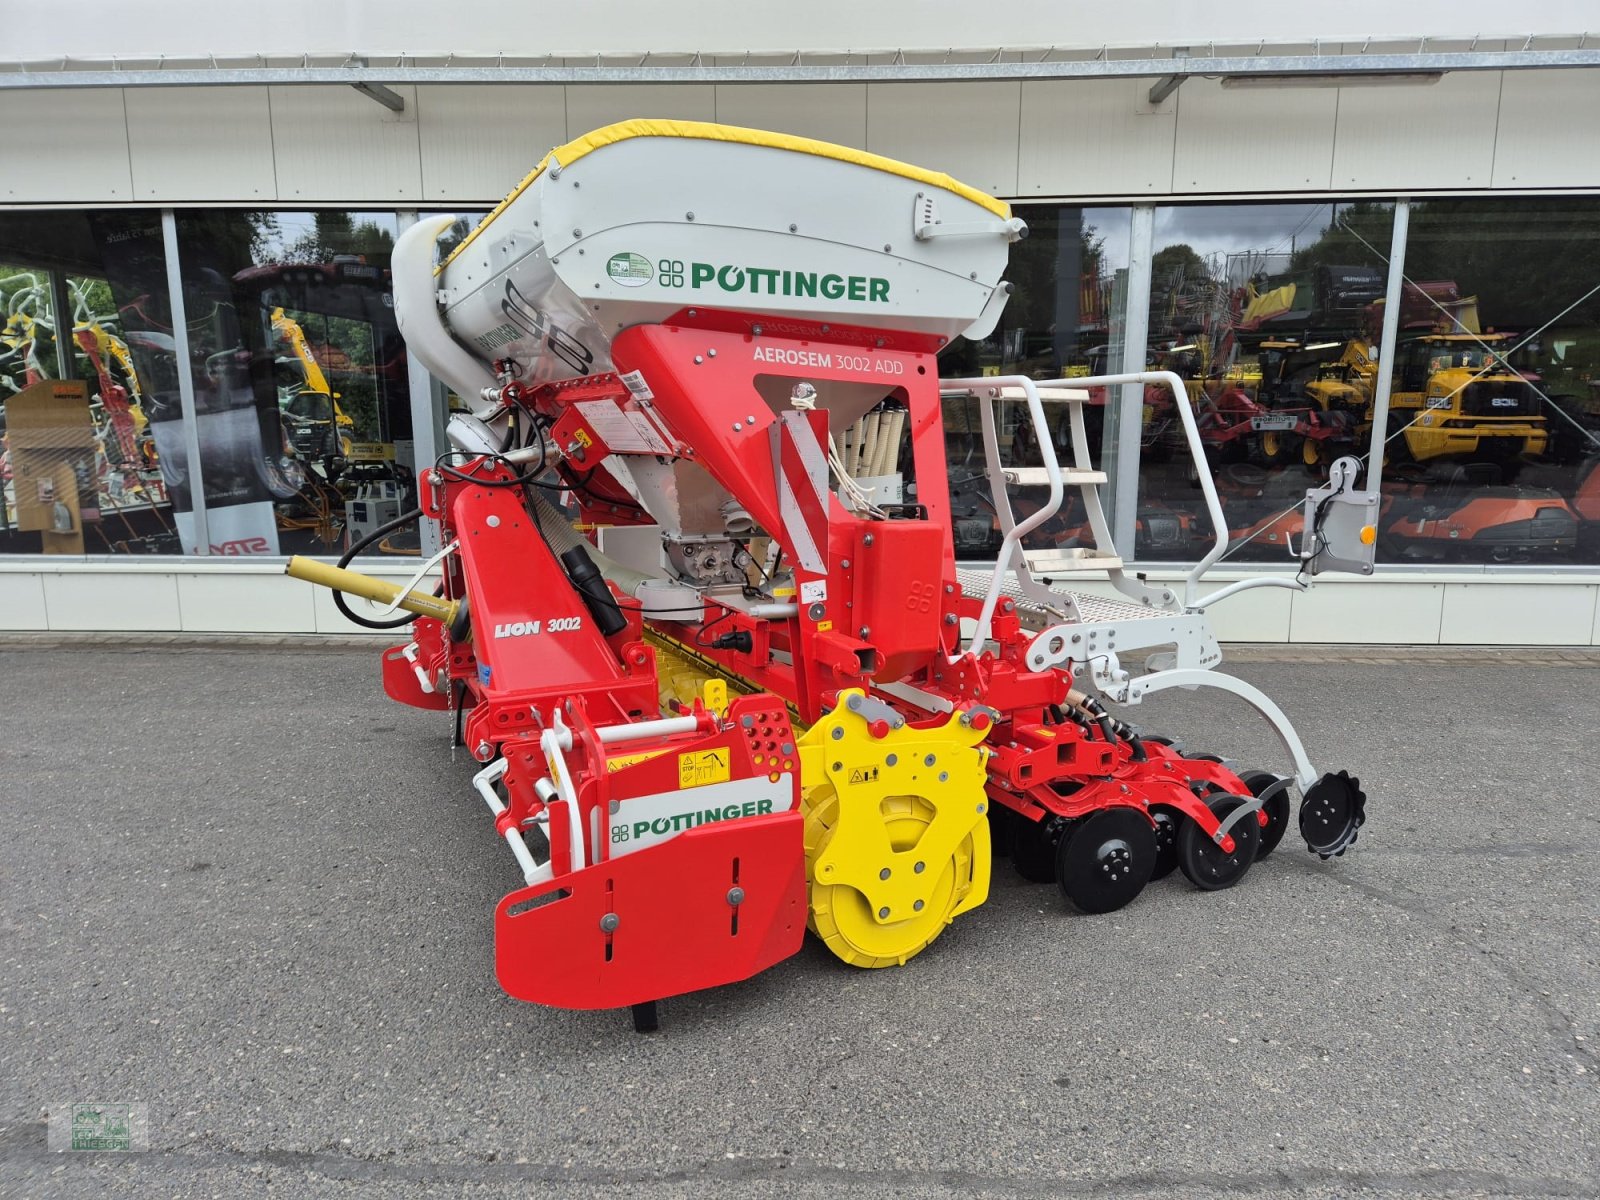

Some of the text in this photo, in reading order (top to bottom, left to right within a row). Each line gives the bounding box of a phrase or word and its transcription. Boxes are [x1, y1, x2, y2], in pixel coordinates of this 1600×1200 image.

[691, 262, 890, 303] PÖTTINGER
[753, 346, 904, 375] AEROSEM 3002 ADD
[494, 616, 581, 639] LION 3002
[633, 798, 773, 839] PÖTTINGER
